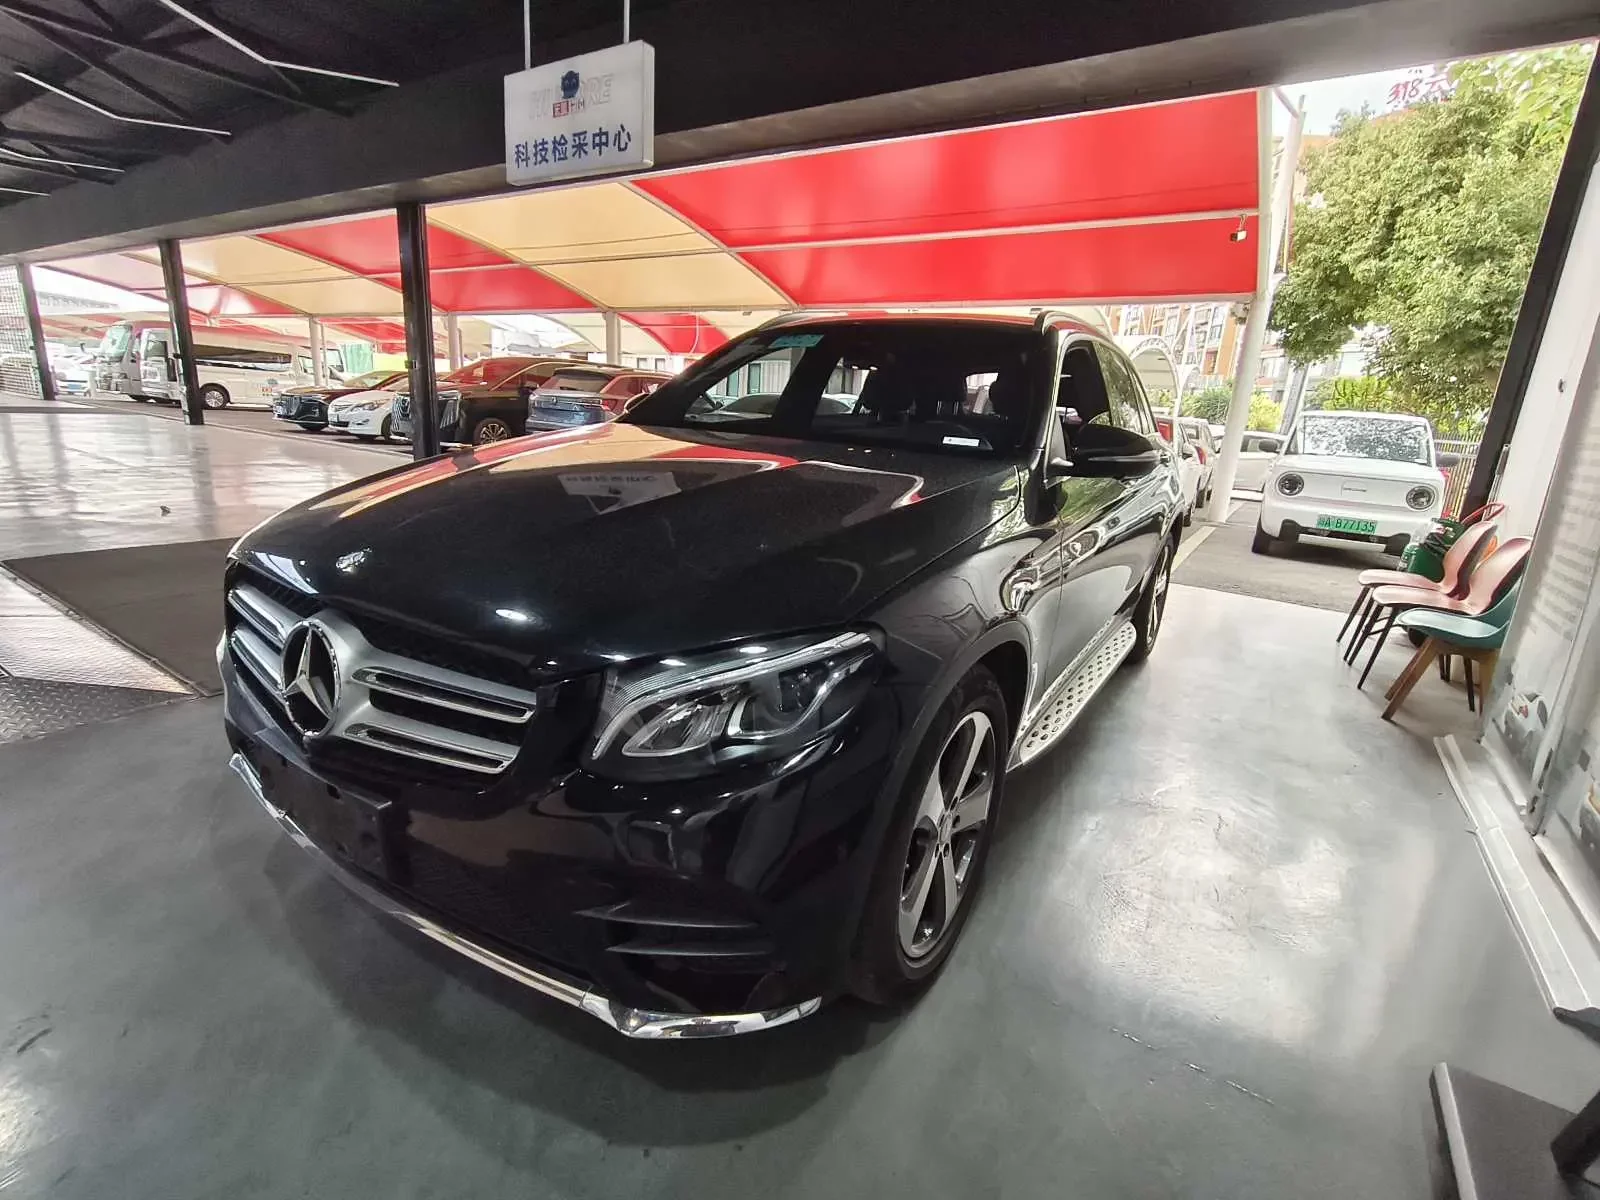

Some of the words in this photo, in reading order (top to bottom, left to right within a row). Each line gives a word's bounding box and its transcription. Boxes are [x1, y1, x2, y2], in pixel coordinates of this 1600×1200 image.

[515, 124, 631, 168] 科技检采中心
